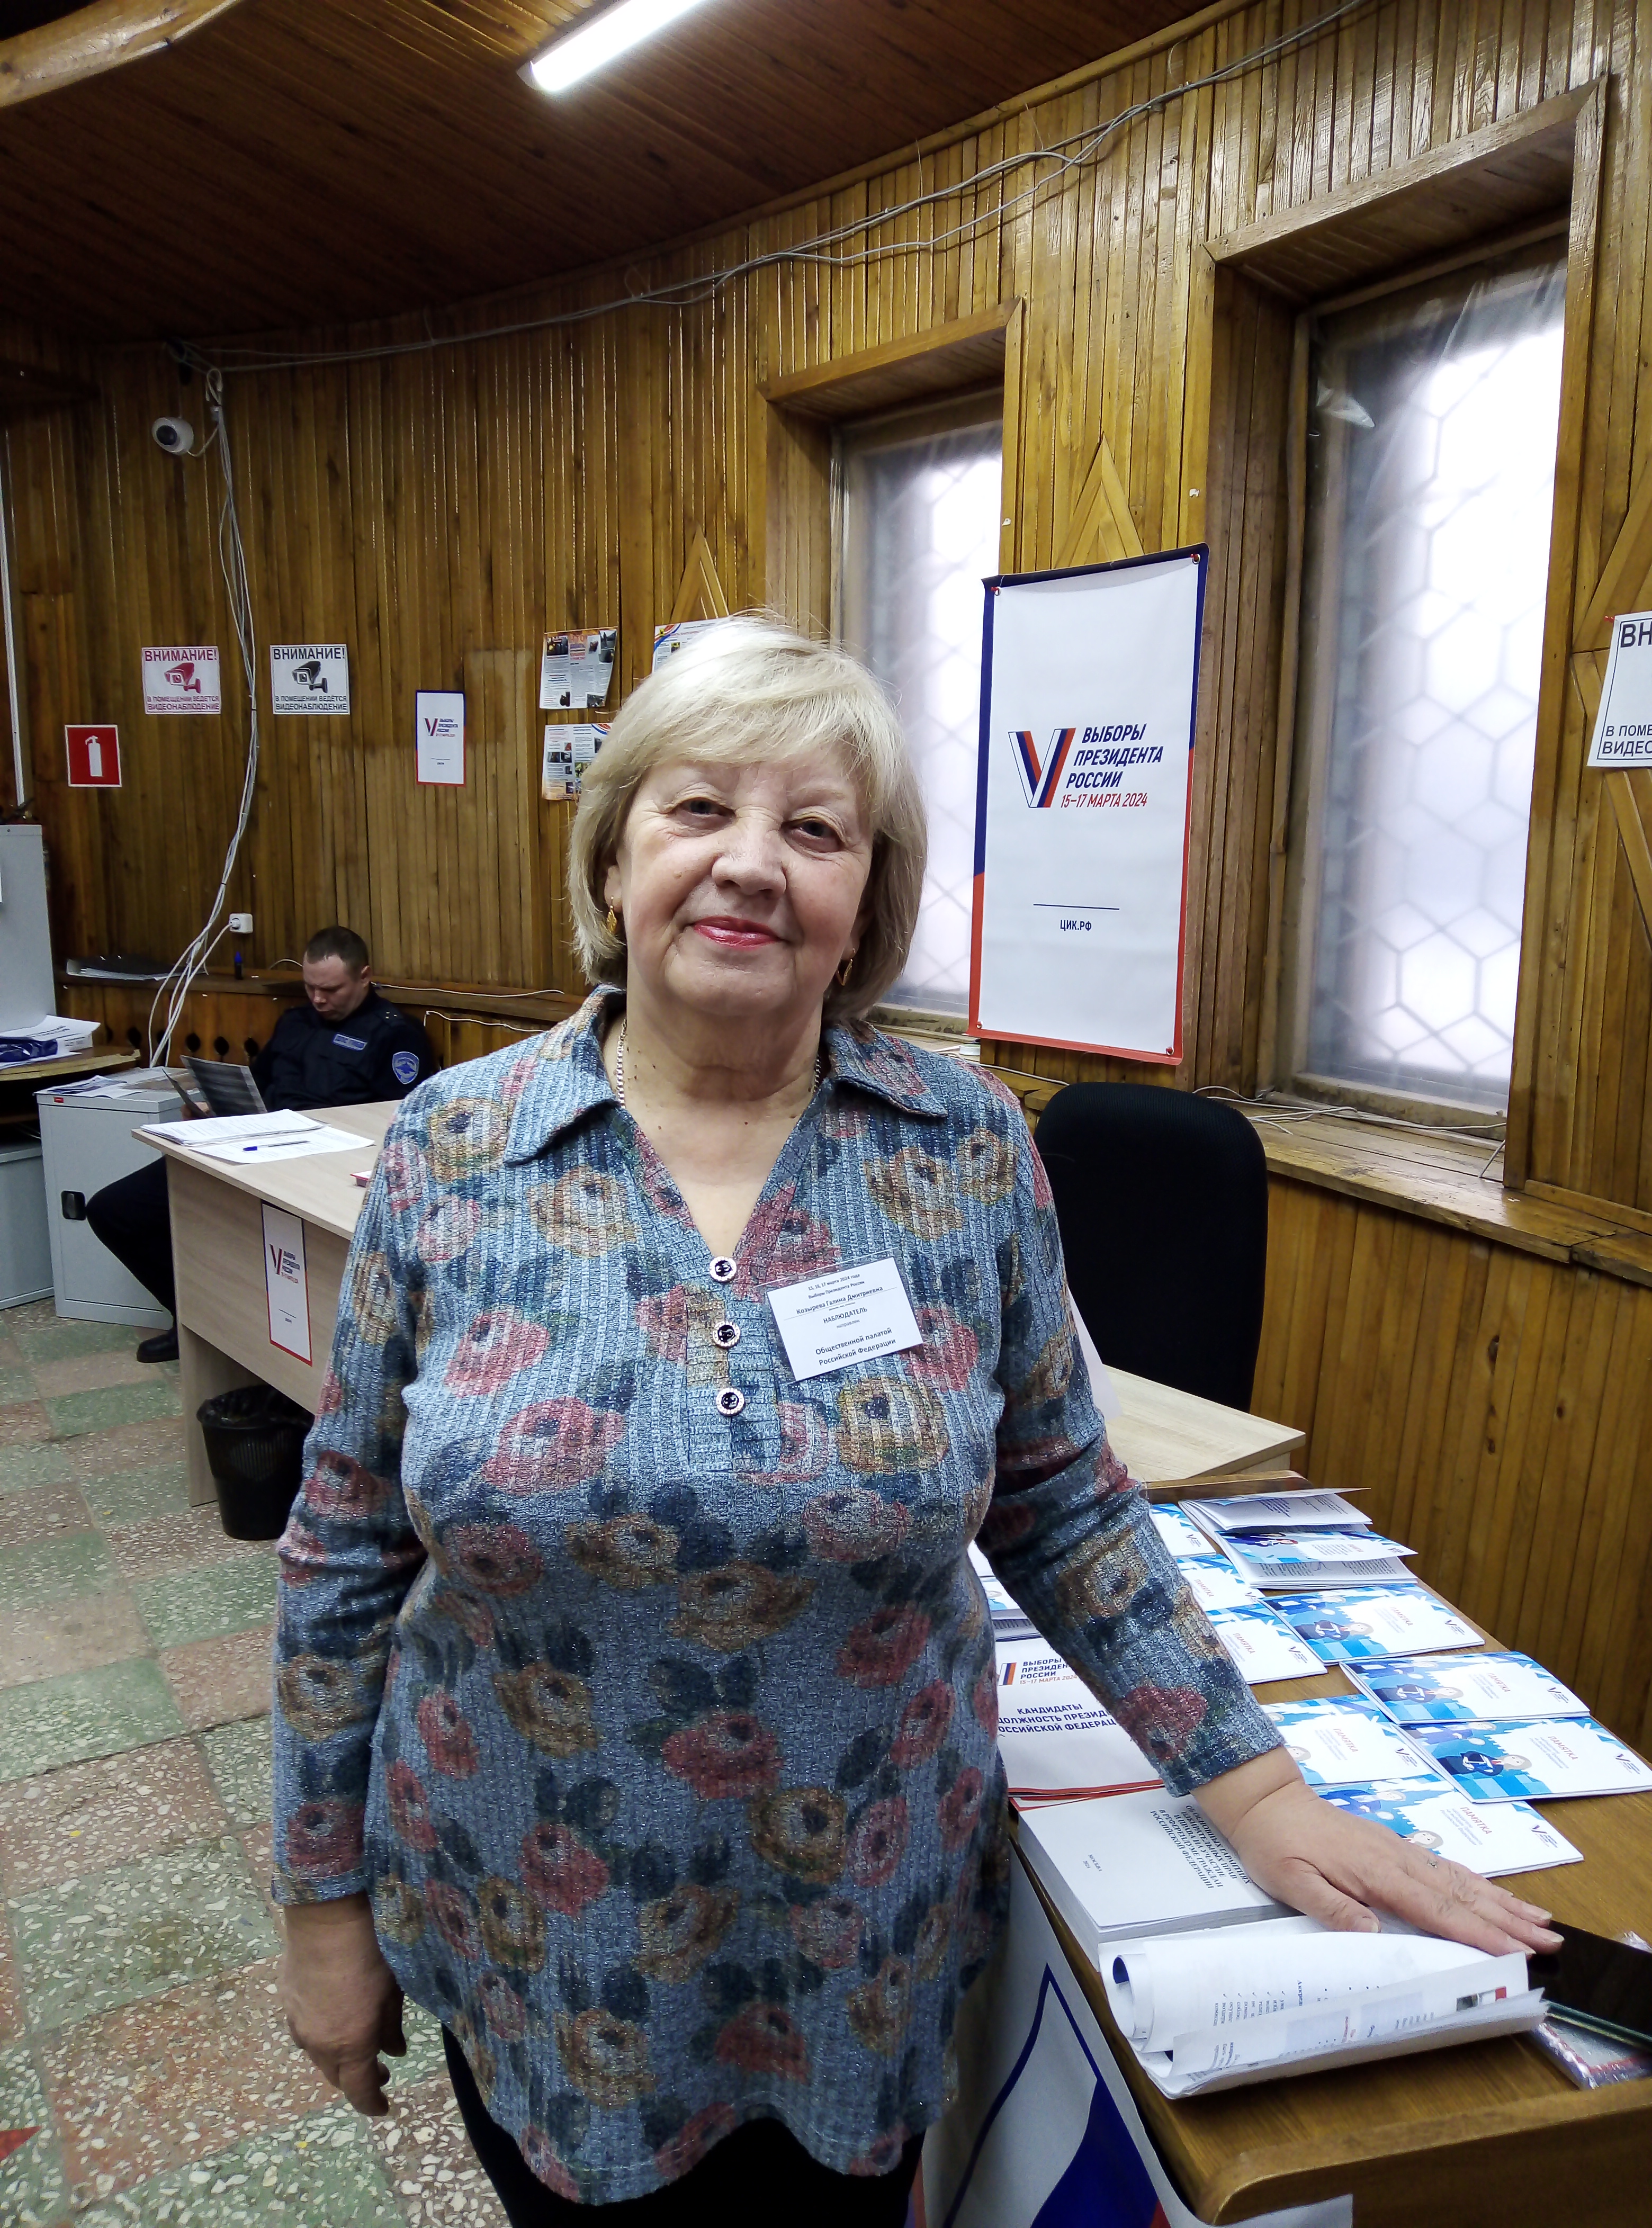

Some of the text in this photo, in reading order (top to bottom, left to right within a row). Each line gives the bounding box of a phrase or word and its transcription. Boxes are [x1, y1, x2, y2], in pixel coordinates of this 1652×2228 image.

[145, 649, 217, 661] ВНИМАНИЕ!
[274, 648, 345, 660] ВНИМАНИЕ!
[1082, 723, 1147, 743] ВЫБОРЫ
[1605, 725, 1614, 736] В
[1073, 746, 1164, 767] ПРЕЗИДЕНТА
[1065, 771, 1124, 788] РОССИИ
[1087, 793, 1121, 807] МАРТА
[1122, 793, 1148, 807] 2024
[1060, 919, 1092, 931] ЦИК.РФ
[796, 1302, 825, 1314] Козырева
[826, 1297, 846, 1306] Галина
[847, 1286, 883, 1301] Дмитриевна
[823, 1307, 867, 1323] НАБЛЮДАТЕЛЬ
[815, 1327, 892, 1355] Общественной палатой
[819, 1339, 896, 1365] Российской Федерации
[1023, 1658, 1062, 1667] ВЫБОРЫ
[1020, 1671, 1056, 1679] РОССИИ
[1017, 1703, 1083, 1714] КАНДИДАТЫ
[998, 1723, 1063, 1733] ОССИЙСКОЙ
[1548, 1736, 1578, 1760] ПАМЯТКА
[1460, 1807, 1493, 1835] ПАМЯТКА
[1150, 1811, 1214, 1889] РОССИЙСКОЙ ФЕДЕРАЦИИ
[1200, 1849, 1226, 1877] УЧАСТИЕ
